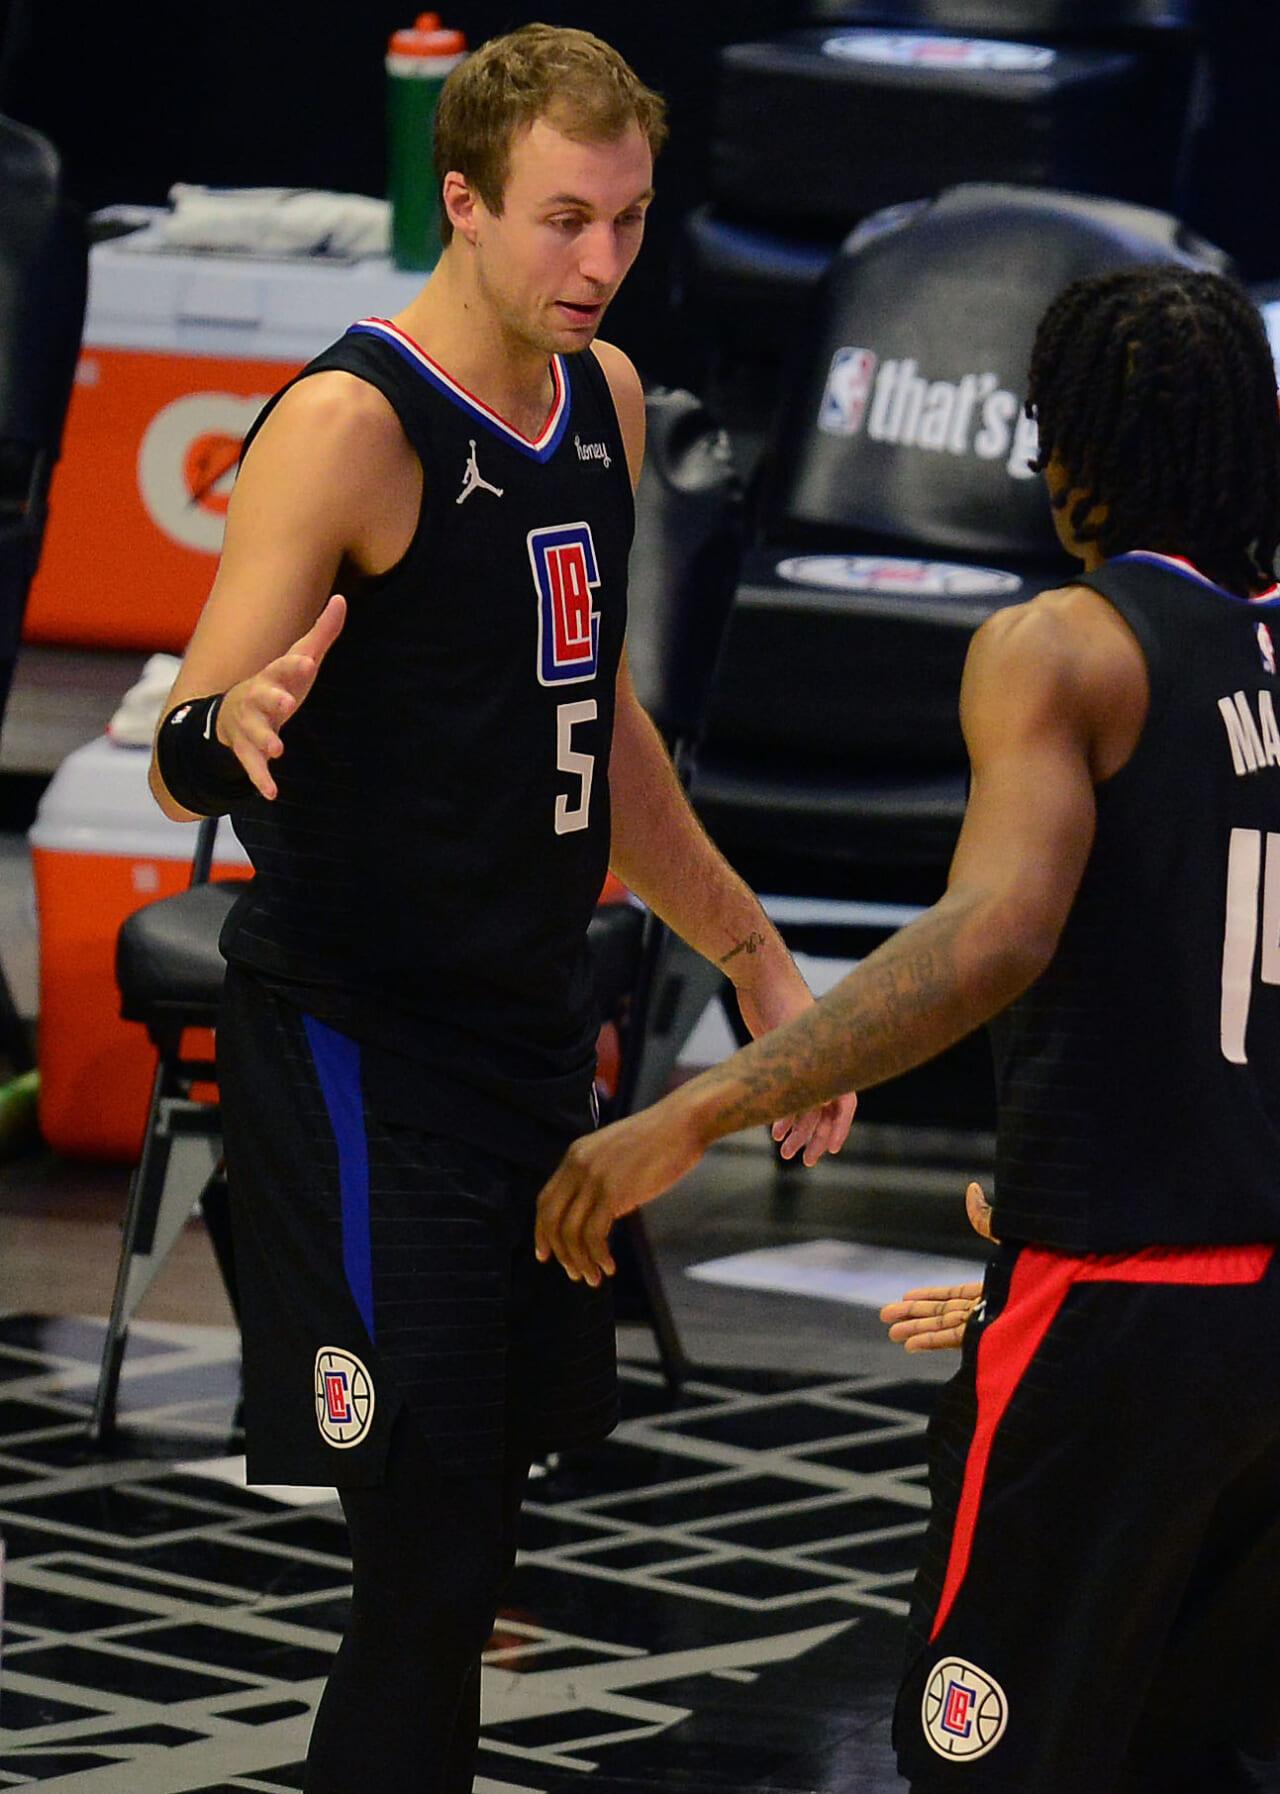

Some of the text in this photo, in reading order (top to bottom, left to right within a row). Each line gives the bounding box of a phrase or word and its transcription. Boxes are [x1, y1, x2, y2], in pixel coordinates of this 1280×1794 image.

[574, 434, 612, 468] honey
[867, 358, 1020, 459] that's
[555, 699, 598, 835] 5
